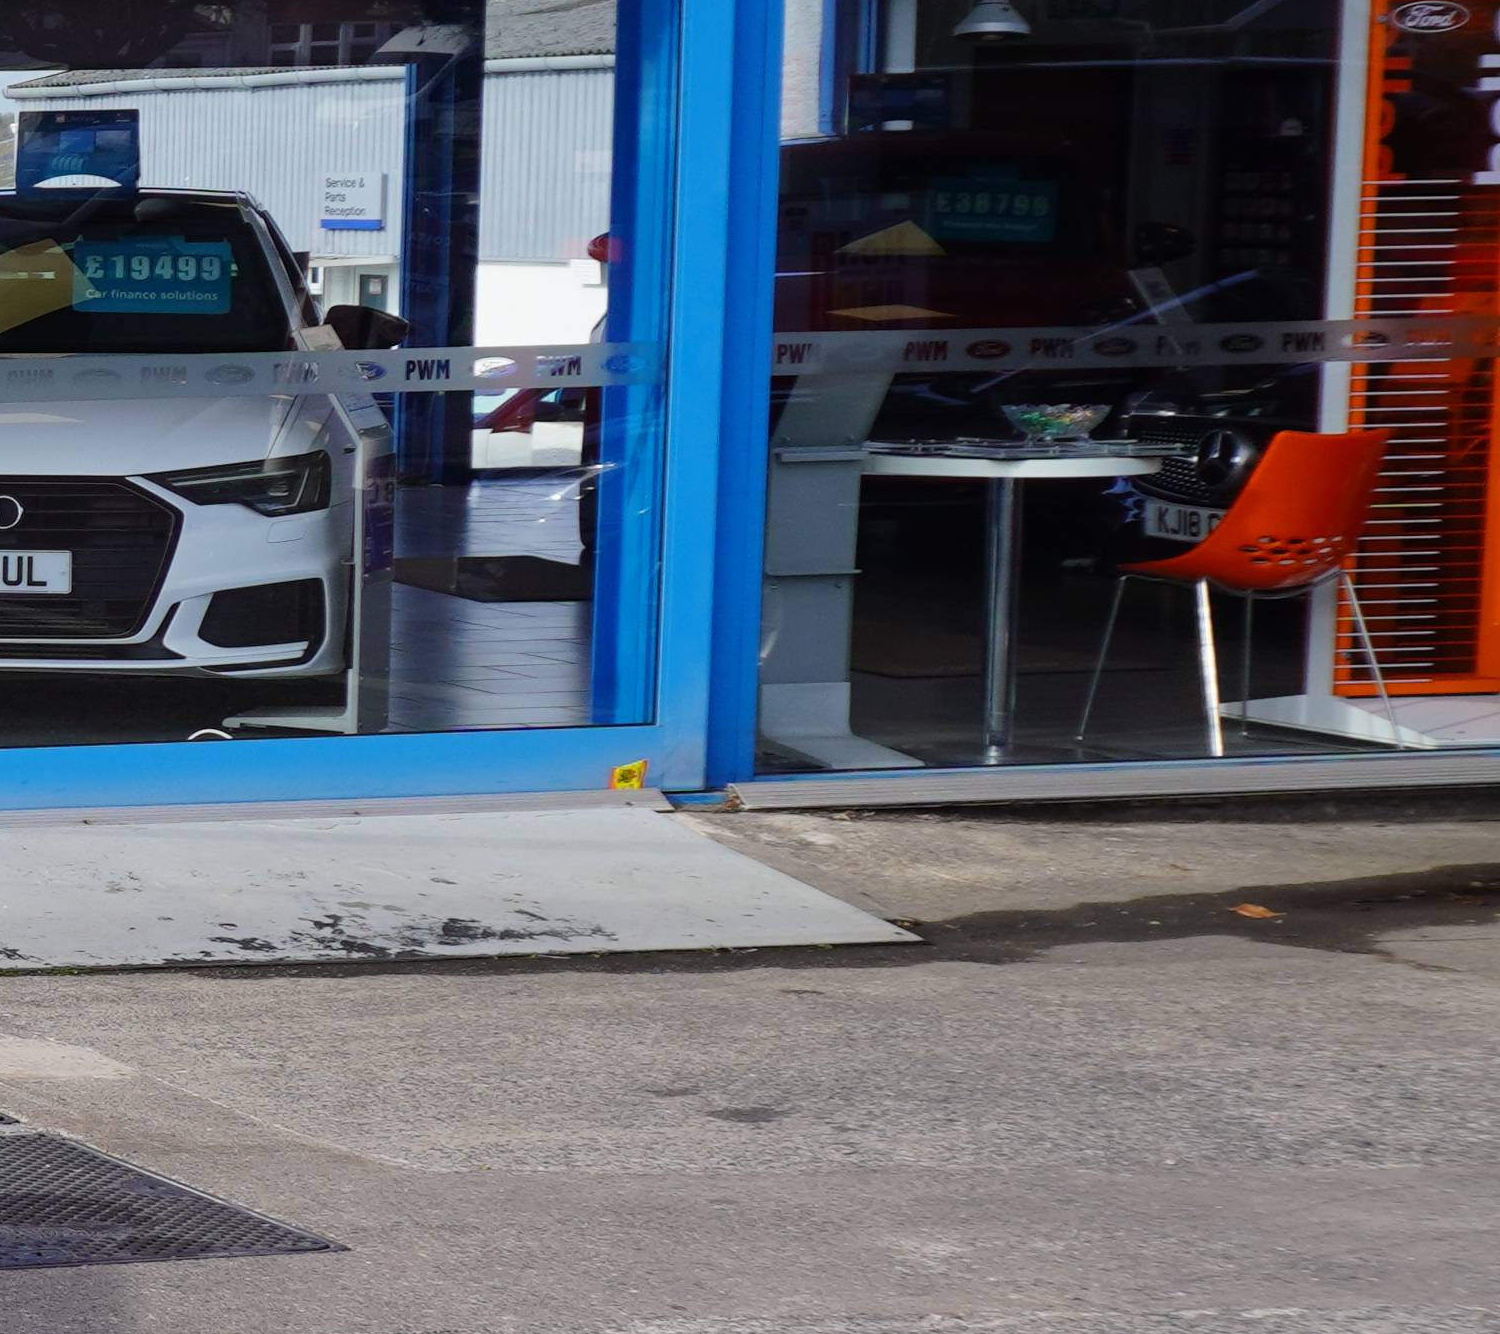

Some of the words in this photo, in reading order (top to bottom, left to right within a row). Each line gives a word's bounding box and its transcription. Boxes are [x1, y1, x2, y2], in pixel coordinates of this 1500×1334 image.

[325, 177, 356, 188] Service
[325, 192, 346, 202] Parts
[325, 206, 366, 217] Reception
[85, 254, 221, 281] £19499
[86, 288, 107, 298] Car
[111, 289, 156, 300] finance
[161, 289, 218, 301] solutions
[777, 343, 813, 364] PW
[405, 359, 450, 380] PWM
